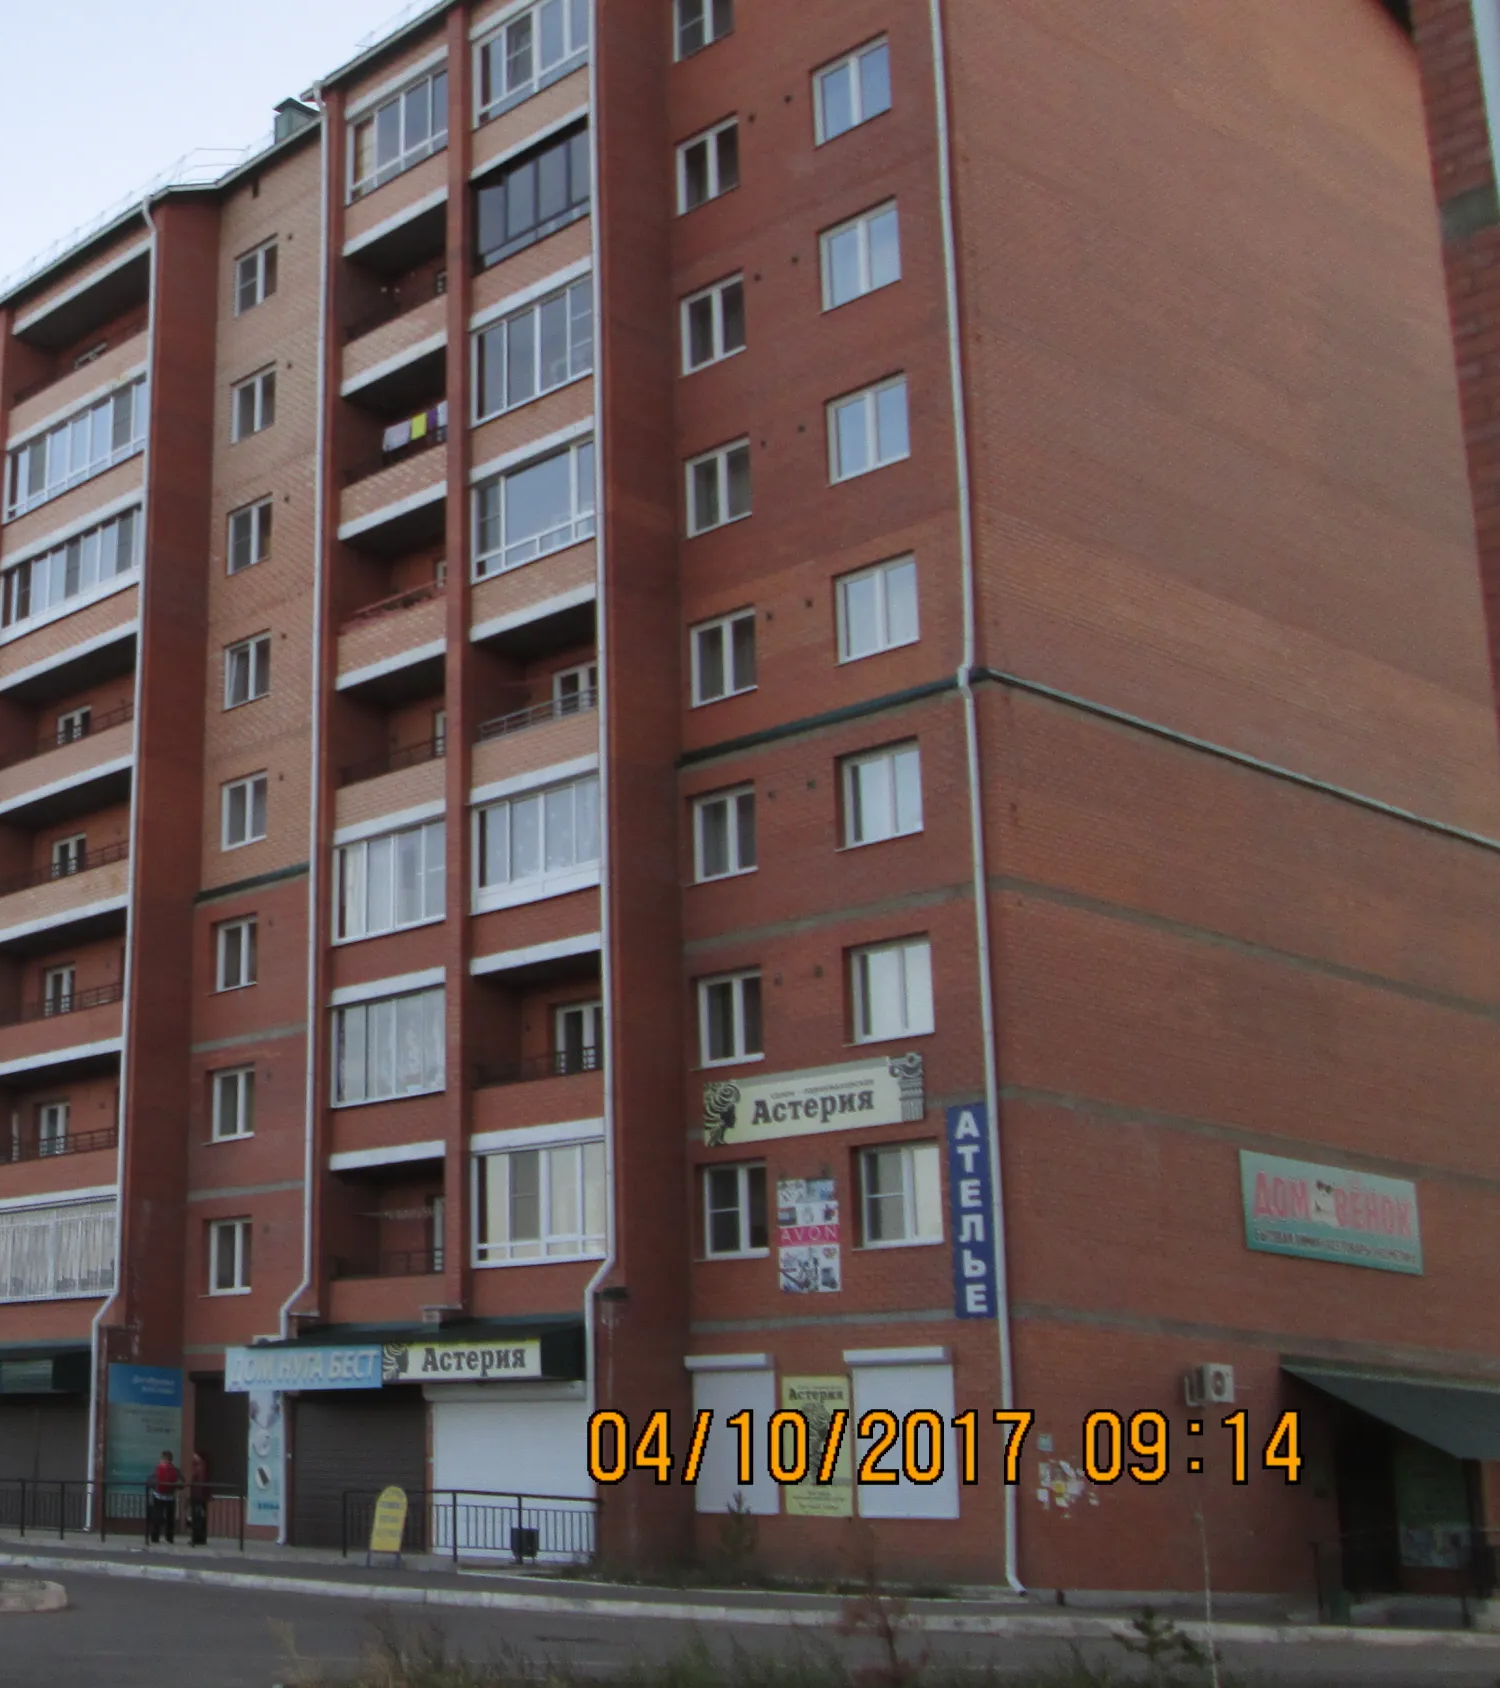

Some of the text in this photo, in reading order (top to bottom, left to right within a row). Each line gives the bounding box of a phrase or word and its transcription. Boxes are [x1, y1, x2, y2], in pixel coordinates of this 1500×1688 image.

[752, 1090, 875, 1125] Астерия
[955, 1110, 989, 1314] АТЕЛЬЕ
[781, 1225, 838, 1243] AVON
[328, 1350, 379, 1382] БЕСТ
[422, 1347, 526, 1377] Астерия
